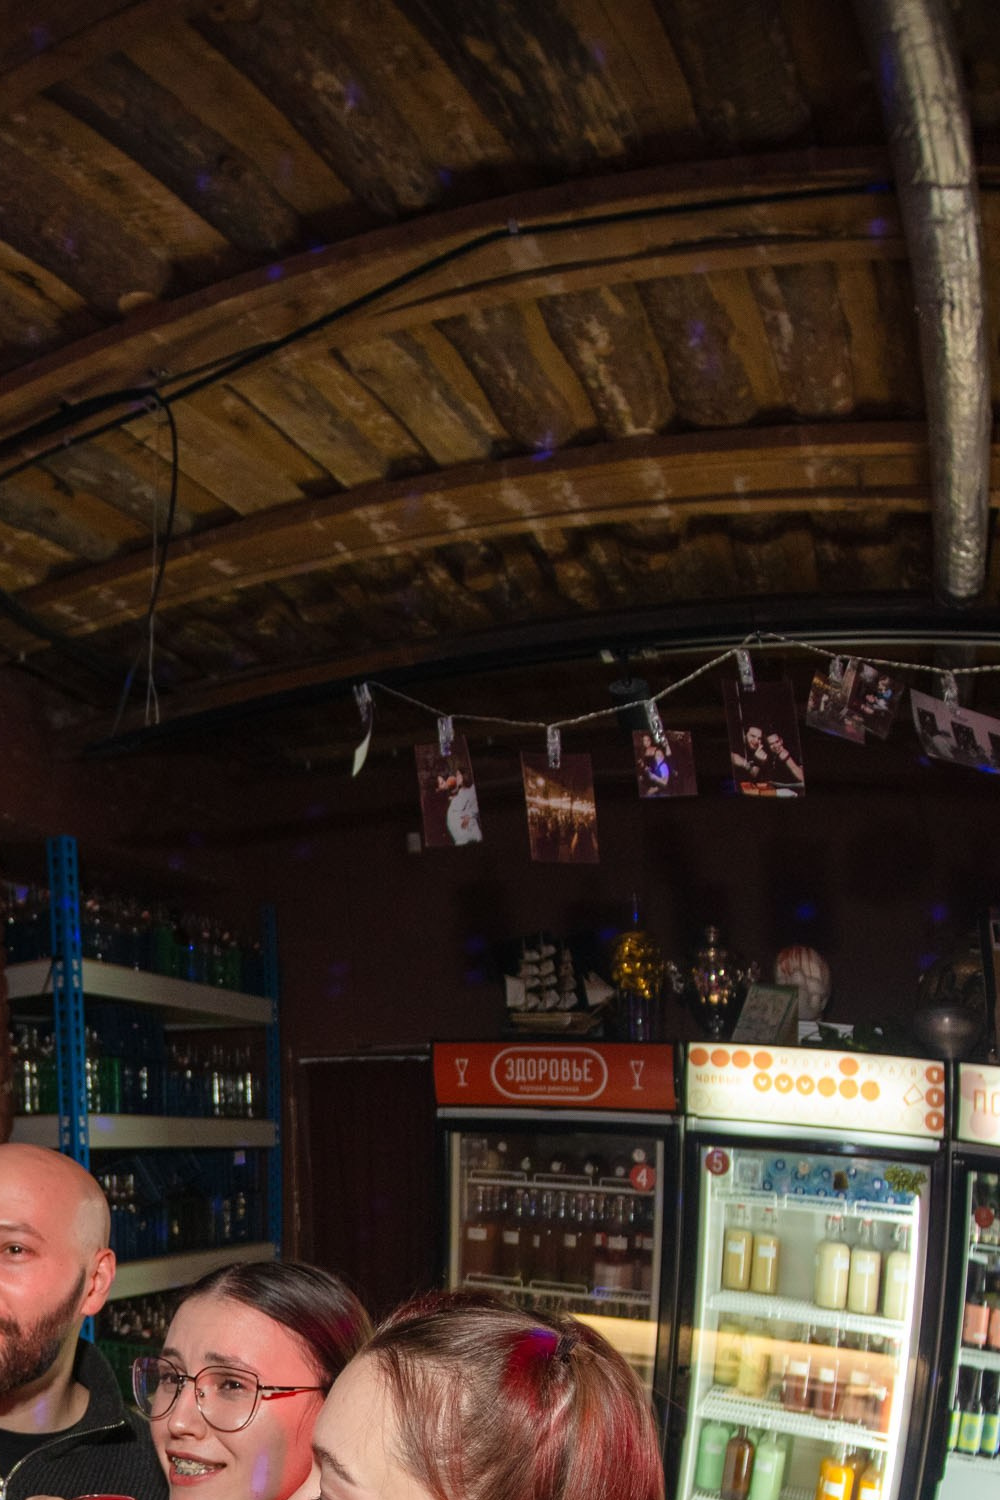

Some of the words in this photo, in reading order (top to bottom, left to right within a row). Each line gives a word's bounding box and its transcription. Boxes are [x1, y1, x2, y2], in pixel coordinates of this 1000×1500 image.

[505, 1058, 594, 1083] ЗДОРОВЬЕ
[712, 1152, 723, 1171] 5
[636, 1170, 648, 1187] 4
